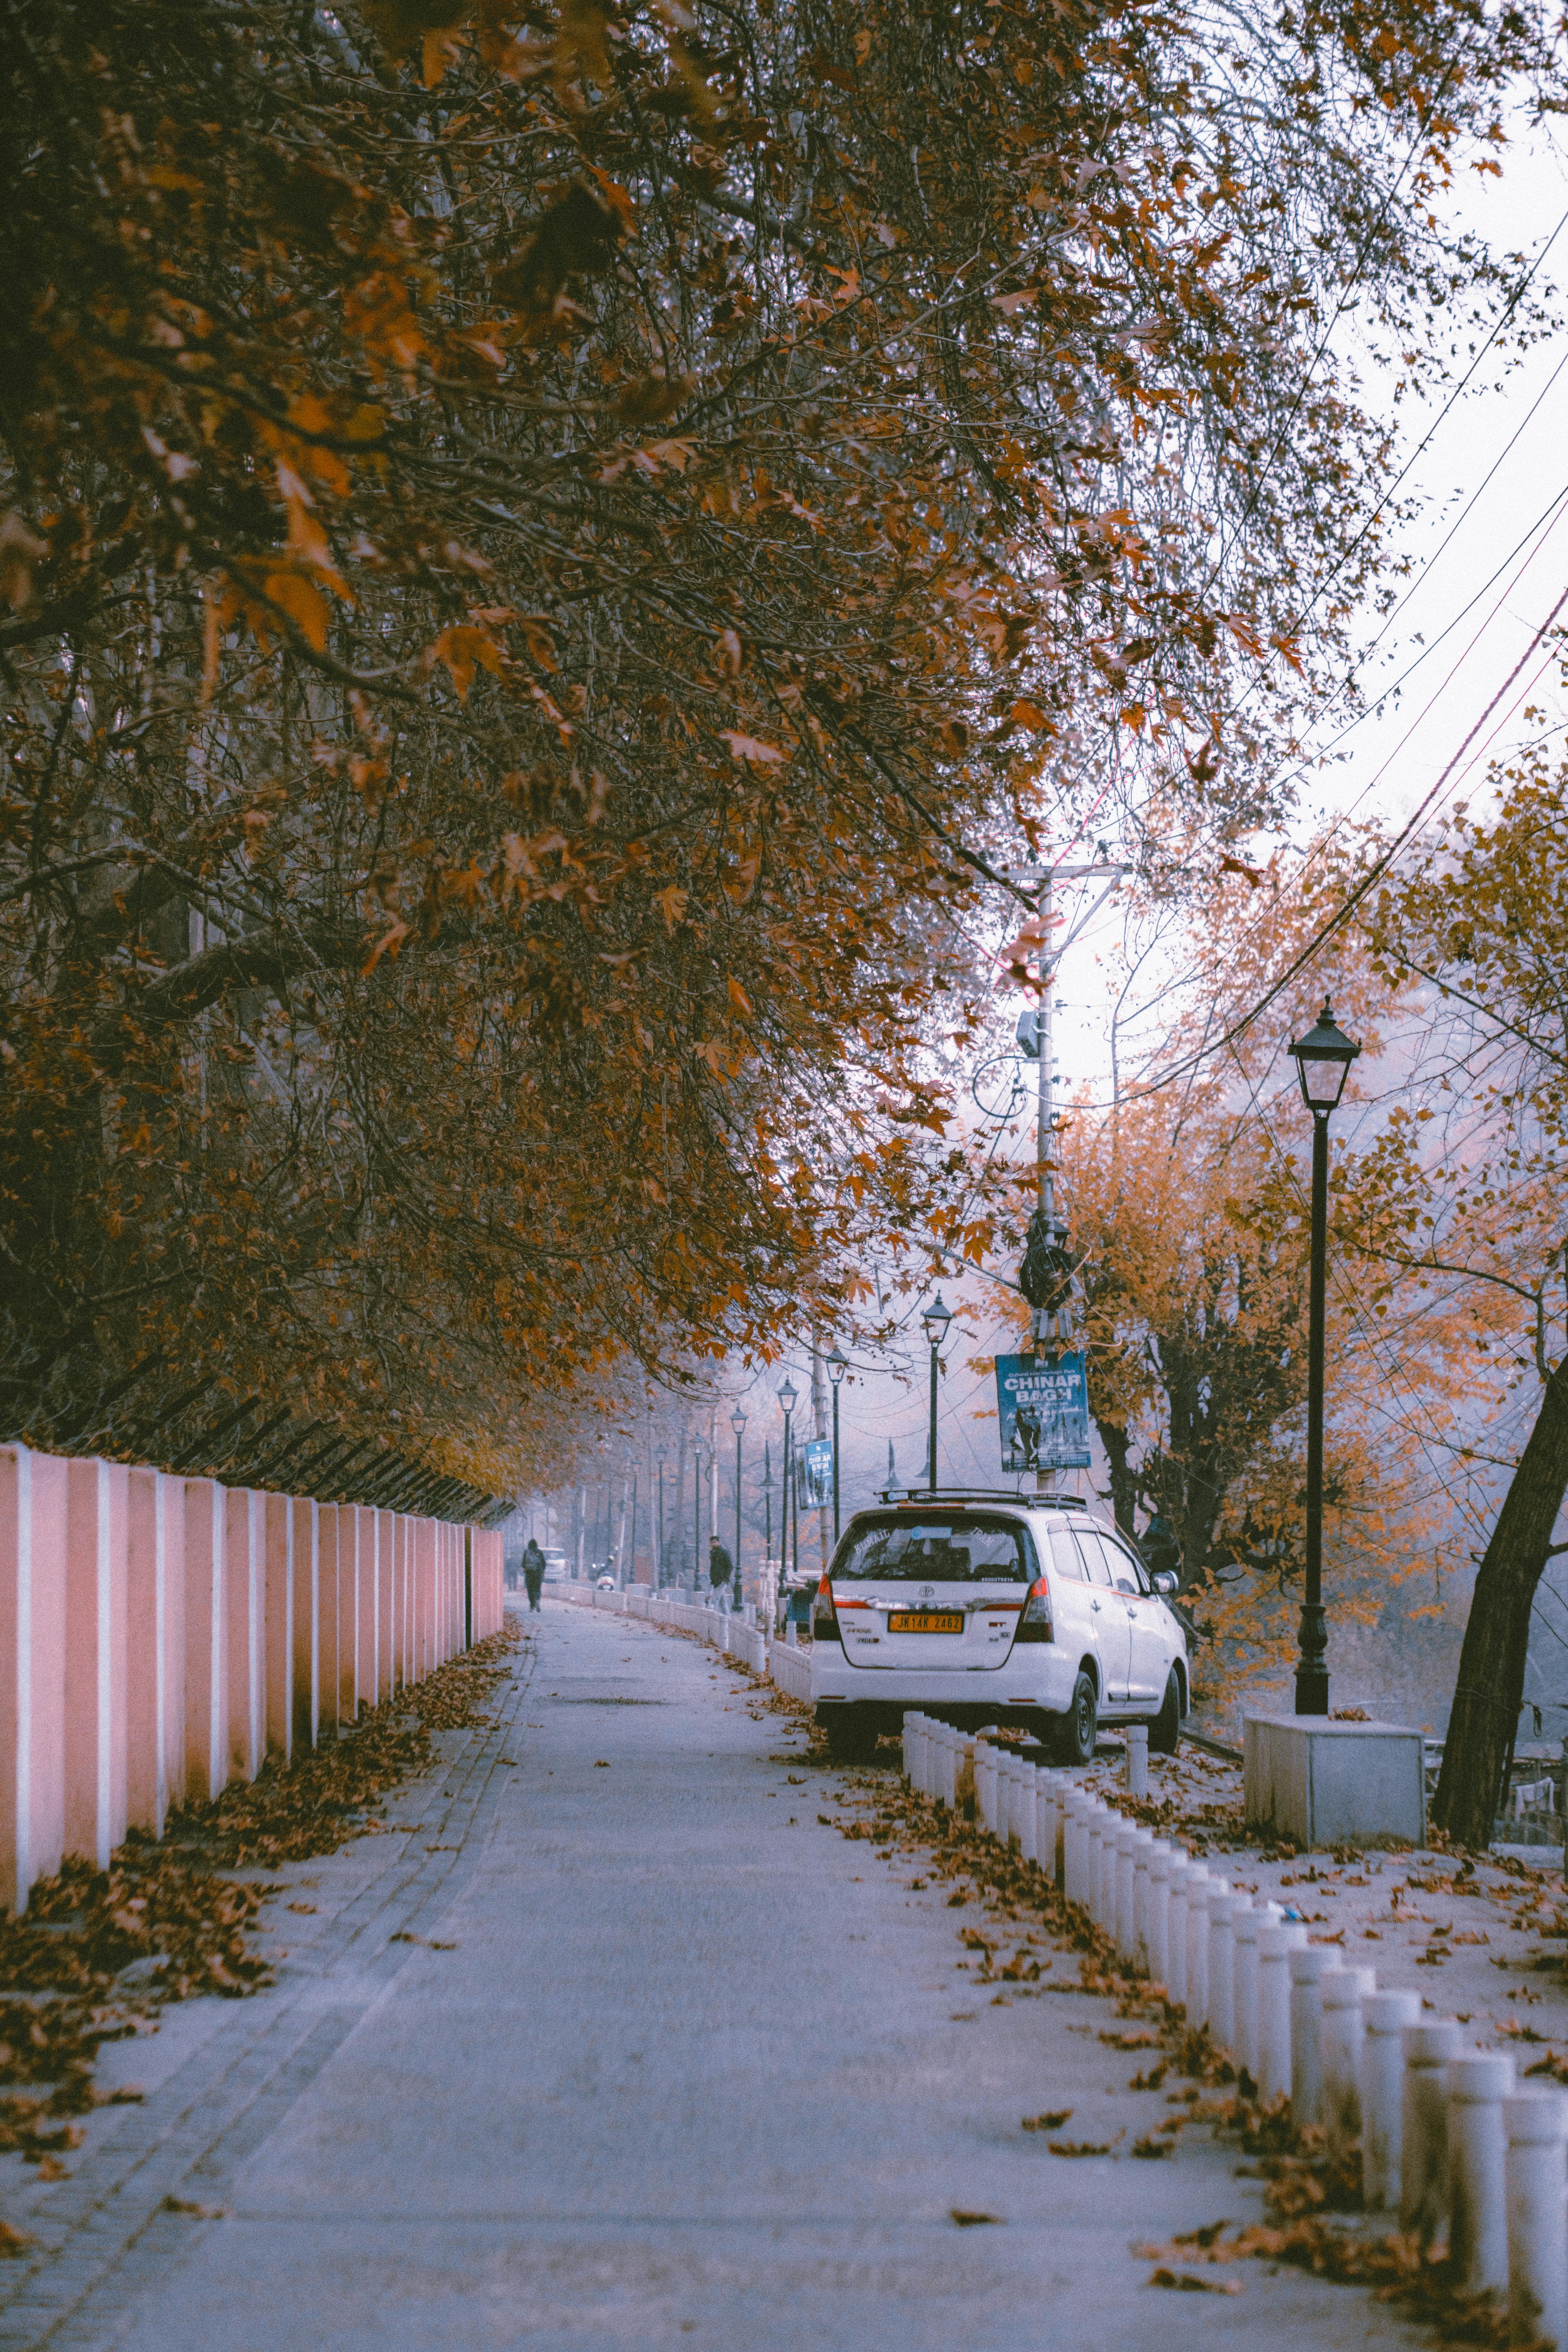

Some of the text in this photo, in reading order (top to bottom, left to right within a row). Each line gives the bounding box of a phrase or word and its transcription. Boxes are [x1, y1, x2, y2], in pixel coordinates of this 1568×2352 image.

[1004, 1374, 1081, 1390] CHINAR
[1016, 1388, 1072, 1403] BAGH
[853, 1530, 891, 1553] KUMAIL
[898, 1617, 959, 1628] JK14K 2462
